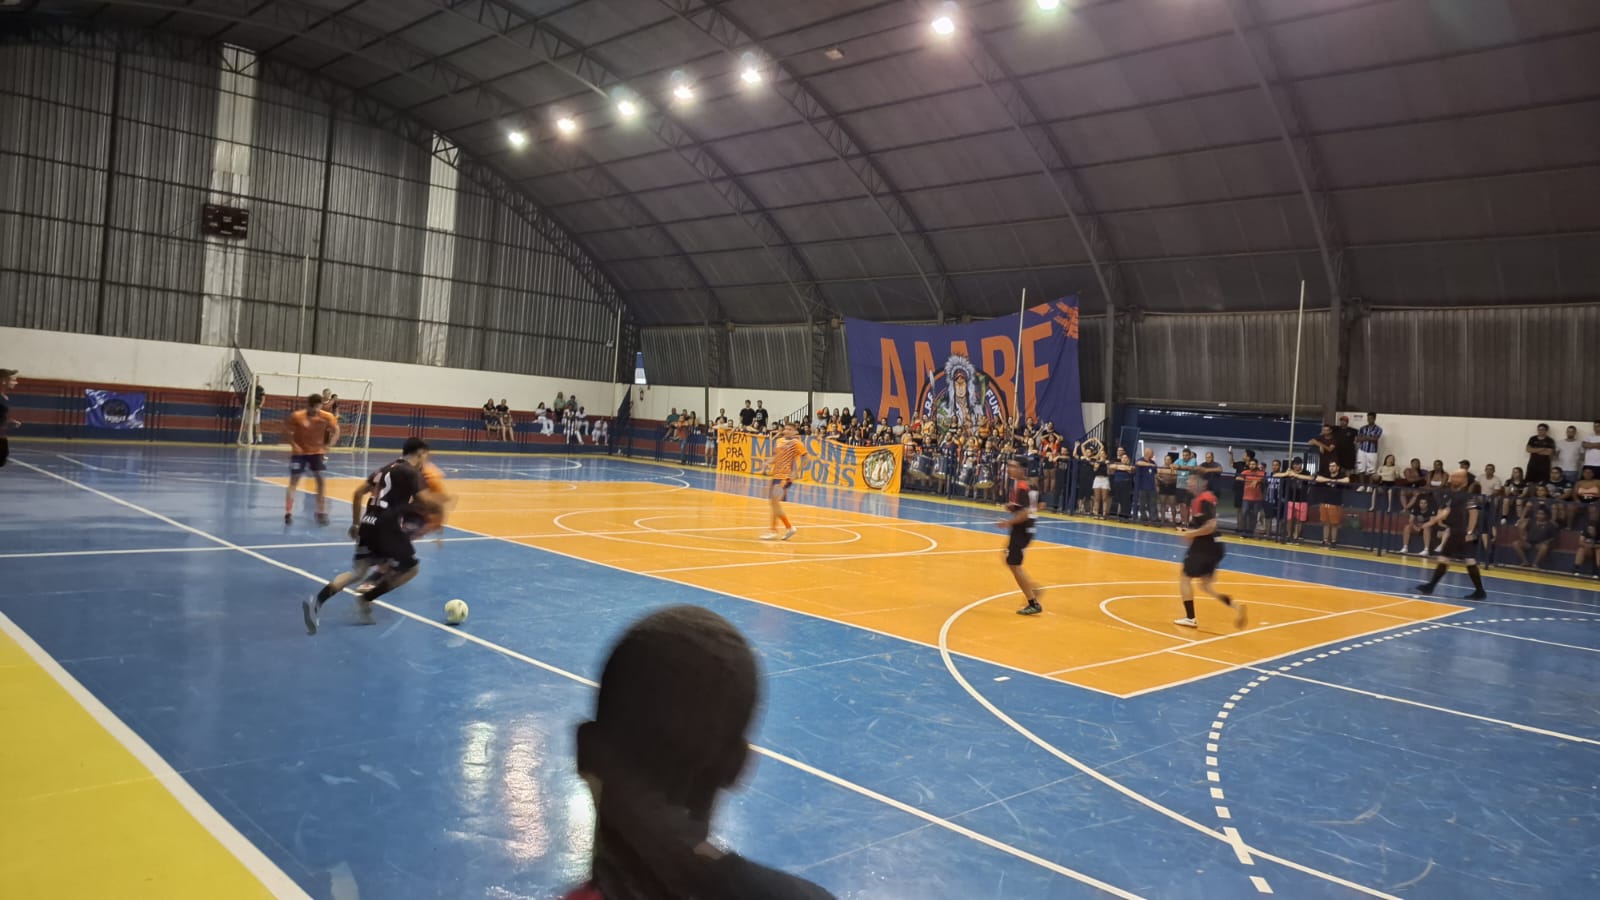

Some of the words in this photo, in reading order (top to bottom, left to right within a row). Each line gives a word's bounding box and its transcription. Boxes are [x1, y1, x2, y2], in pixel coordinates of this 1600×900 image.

[878, 321, 1053, 425] AARF
[726, 447, 744, 458] PRA
[752, 435, 857, 466] MCINA
[720, 457, 747, 471] TRIBO
